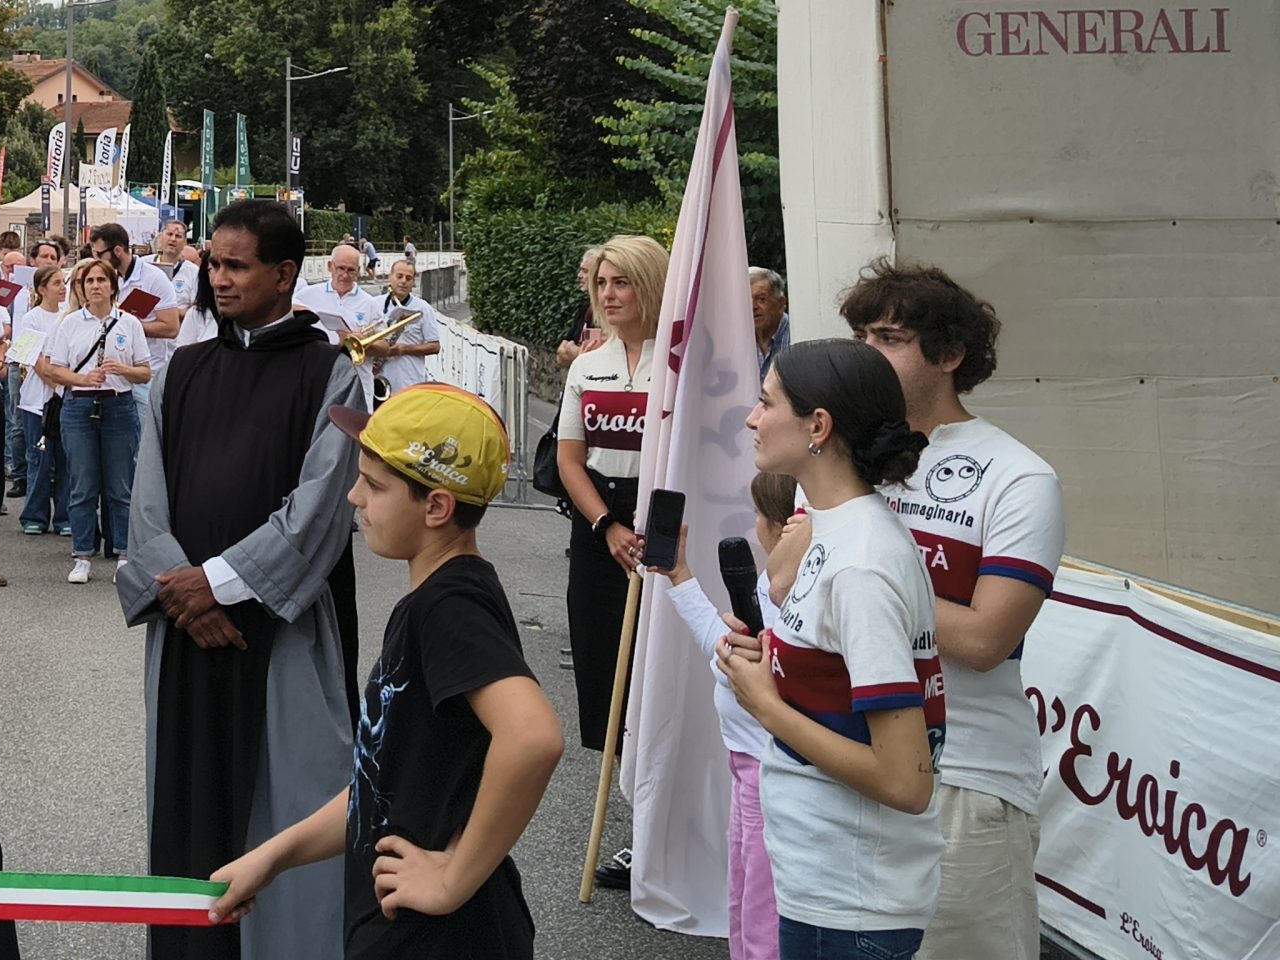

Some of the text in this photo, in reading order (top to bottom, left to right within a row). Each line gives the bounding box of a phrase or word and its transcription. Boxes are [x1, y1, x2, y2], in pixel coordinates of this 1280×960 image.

[955, 8, 1231, 57] GENERALI
[51, 129, 64, 179] vittoria
[99, 134, 113, 166] toria
[583, 403, 647, 433] Eroic
[403, 440, 470, 485] L'Eroica
